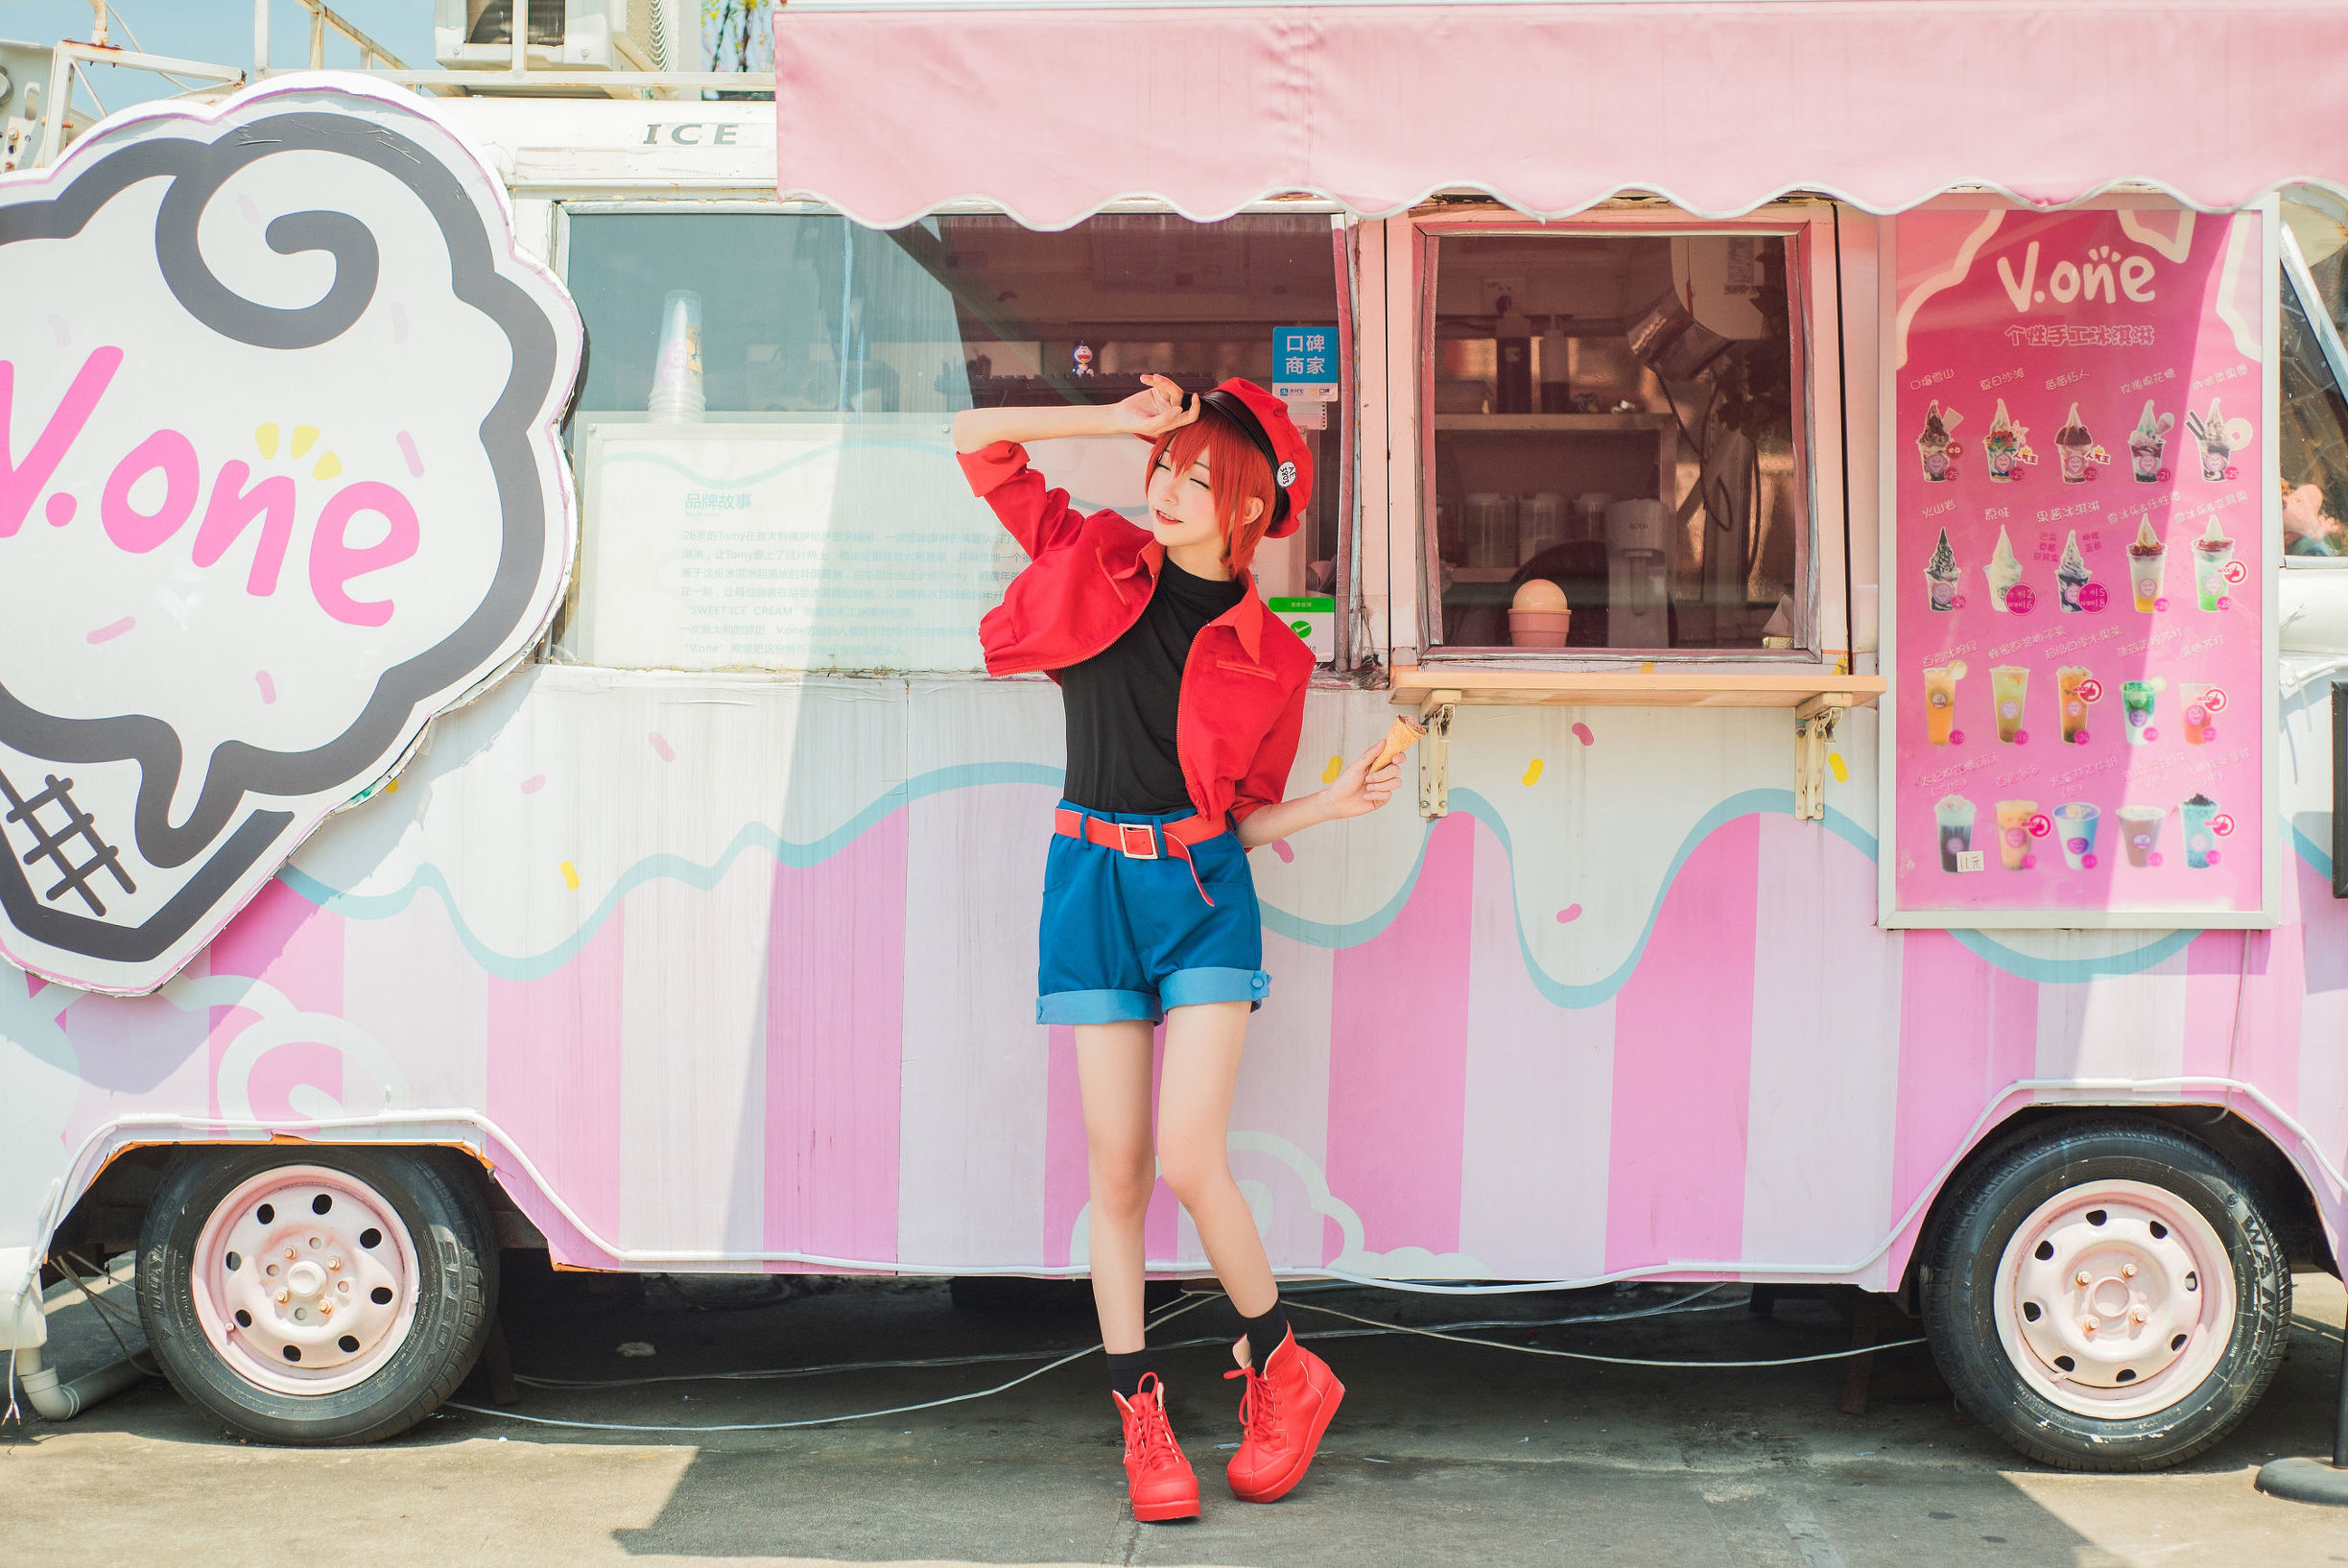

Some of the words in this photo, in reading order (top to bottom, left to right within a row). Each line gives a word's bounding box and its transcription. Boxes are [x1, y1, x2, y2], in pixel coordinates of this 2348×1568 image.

[643, 124, 738, 145] ICE
[1997, 241, 2156, 312] V.one
[1287, 334, 1325, 352] 口碑
[2004, 323, 2155, 346] 个性手工冰淇淋
[1286, 356, 1325, 374] 商家
[684, 492, 752, 510] 品牌故事
[1922, 499, 1957, 519] 火山岩
[1984, 506, 2010, 521] 原味
[2036, 500, 2101, 522] 果酱冰淇淋
[730, 606, 747, 615] ICE
